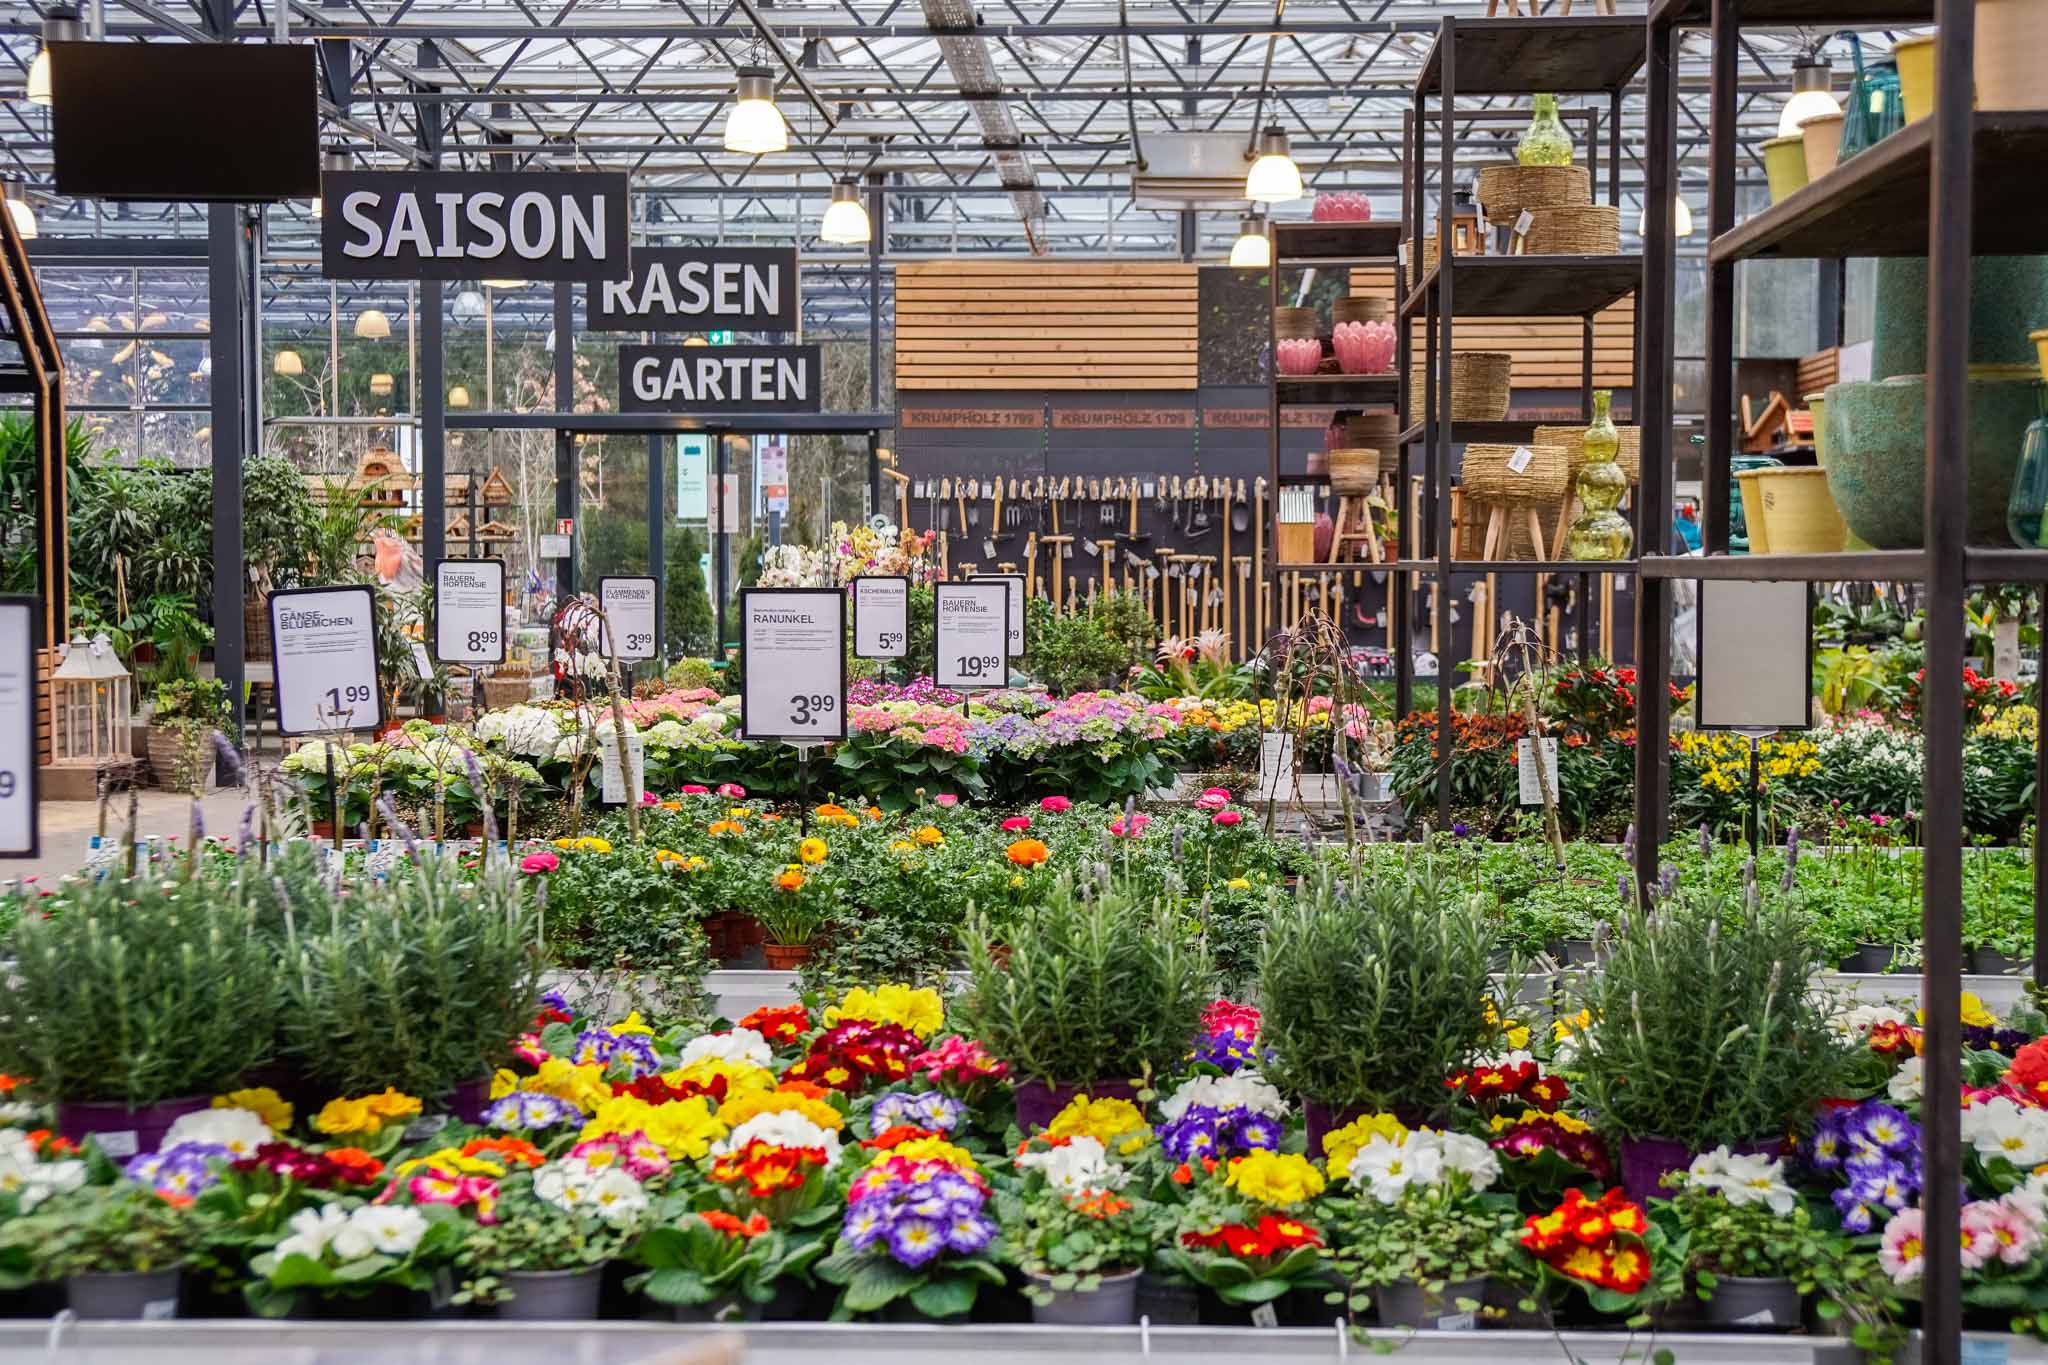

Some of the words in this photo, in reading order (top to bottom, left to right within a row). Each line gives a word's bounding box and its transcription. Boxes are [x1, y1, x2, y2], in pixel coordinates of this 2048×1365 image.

[342, 191, 606, 260] SAISON
[603, 262, 779, 315] RASEN
[632, 357, 806, 401] GARTEN
[911, 412, 1001, 425] KRUMPHOLZ
[1060, 412, 1153, 425] KRUMPHOLZ
[280, 617, 353, 630] BLUEMCHEN
[753, 614, 815, 624] RANUNKEL
[467, 631, 498, 653] 8.99
[626, 633, 652, 651] 3.99
[879, 632, 903, 650] 5.99
[957, 655, 1000, 678] 19.99
[790, 695, 834, 726] 3.99
